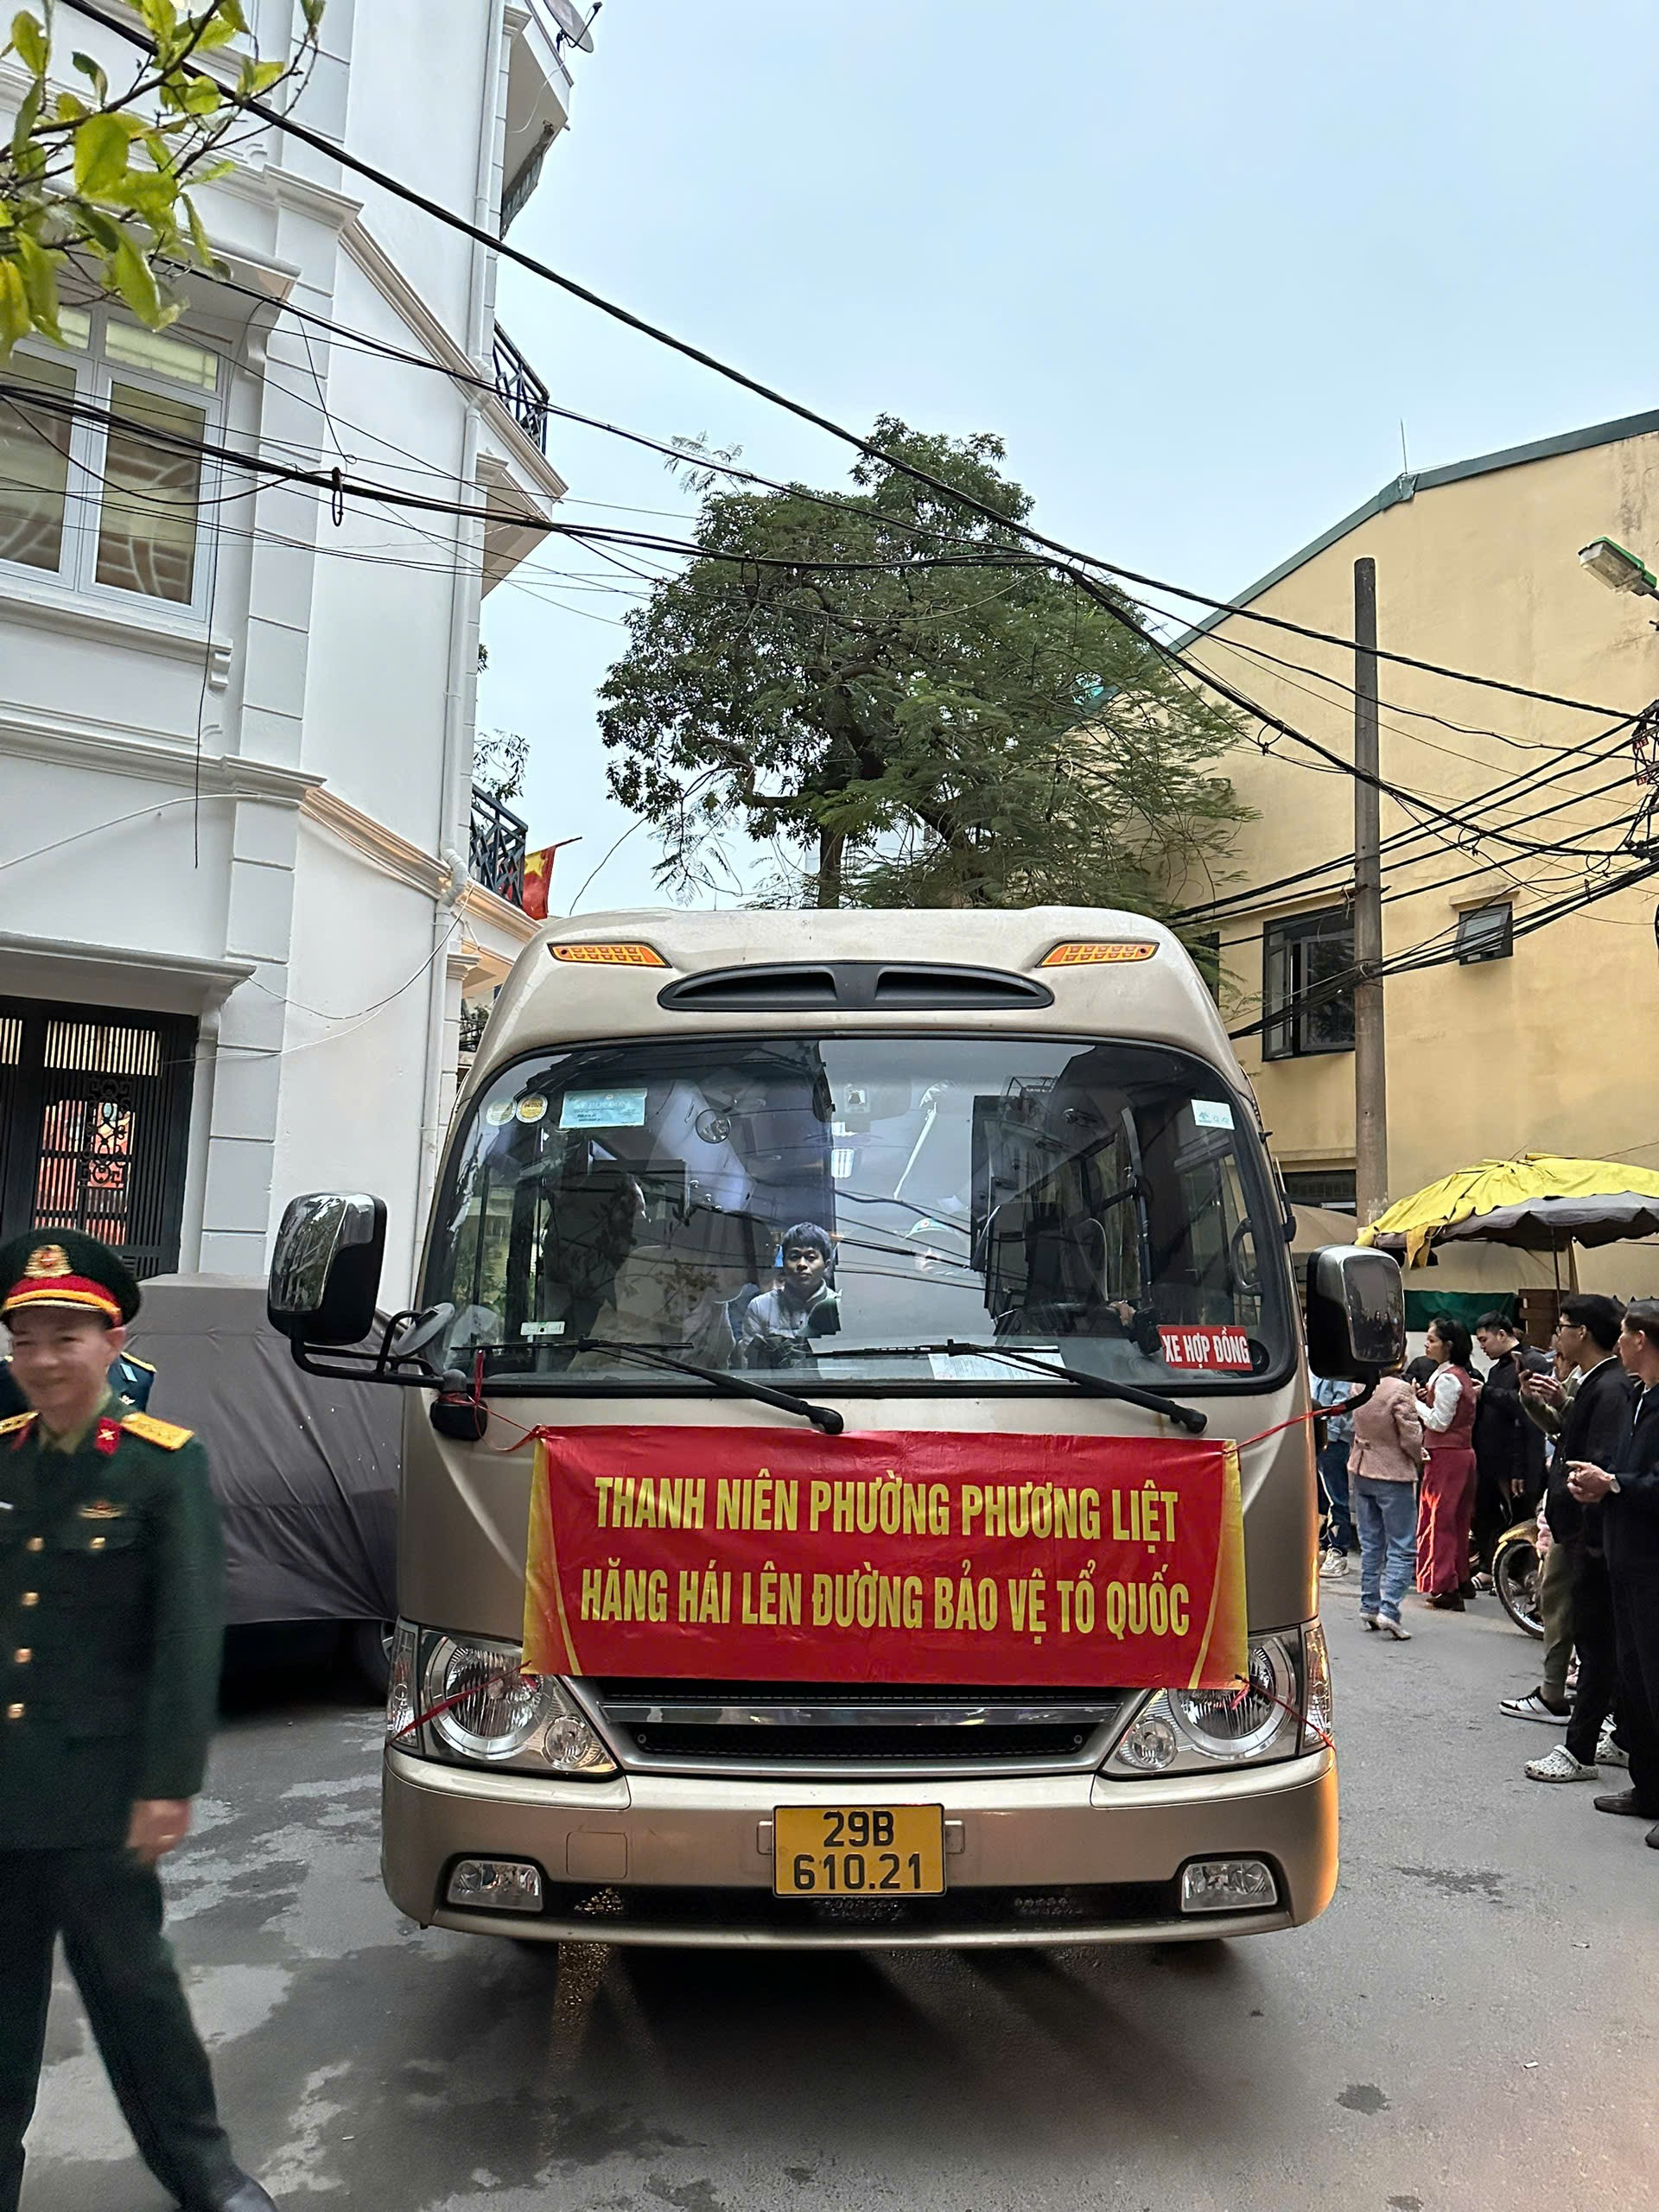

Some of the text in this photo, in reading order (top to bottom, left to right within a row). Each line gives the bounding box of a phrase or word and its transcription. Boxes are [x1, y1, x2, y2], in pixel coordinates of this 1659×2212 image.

[1161, 1326, 1250, 1369] XE HỢP ĐỒNG
[594, 1468, 1179, 1554] THANH NIÊN PHƯỜNG PHƯƠNG LIỆT
[581, 1557, 1190, 1644] HĂNG HÁI LÊN ĐƯỜNG BẢO VỆ TỔ QUỐC
[823, 1810, 894, 1847] 29B
[793, 1853, 921, 1891] 610.21
